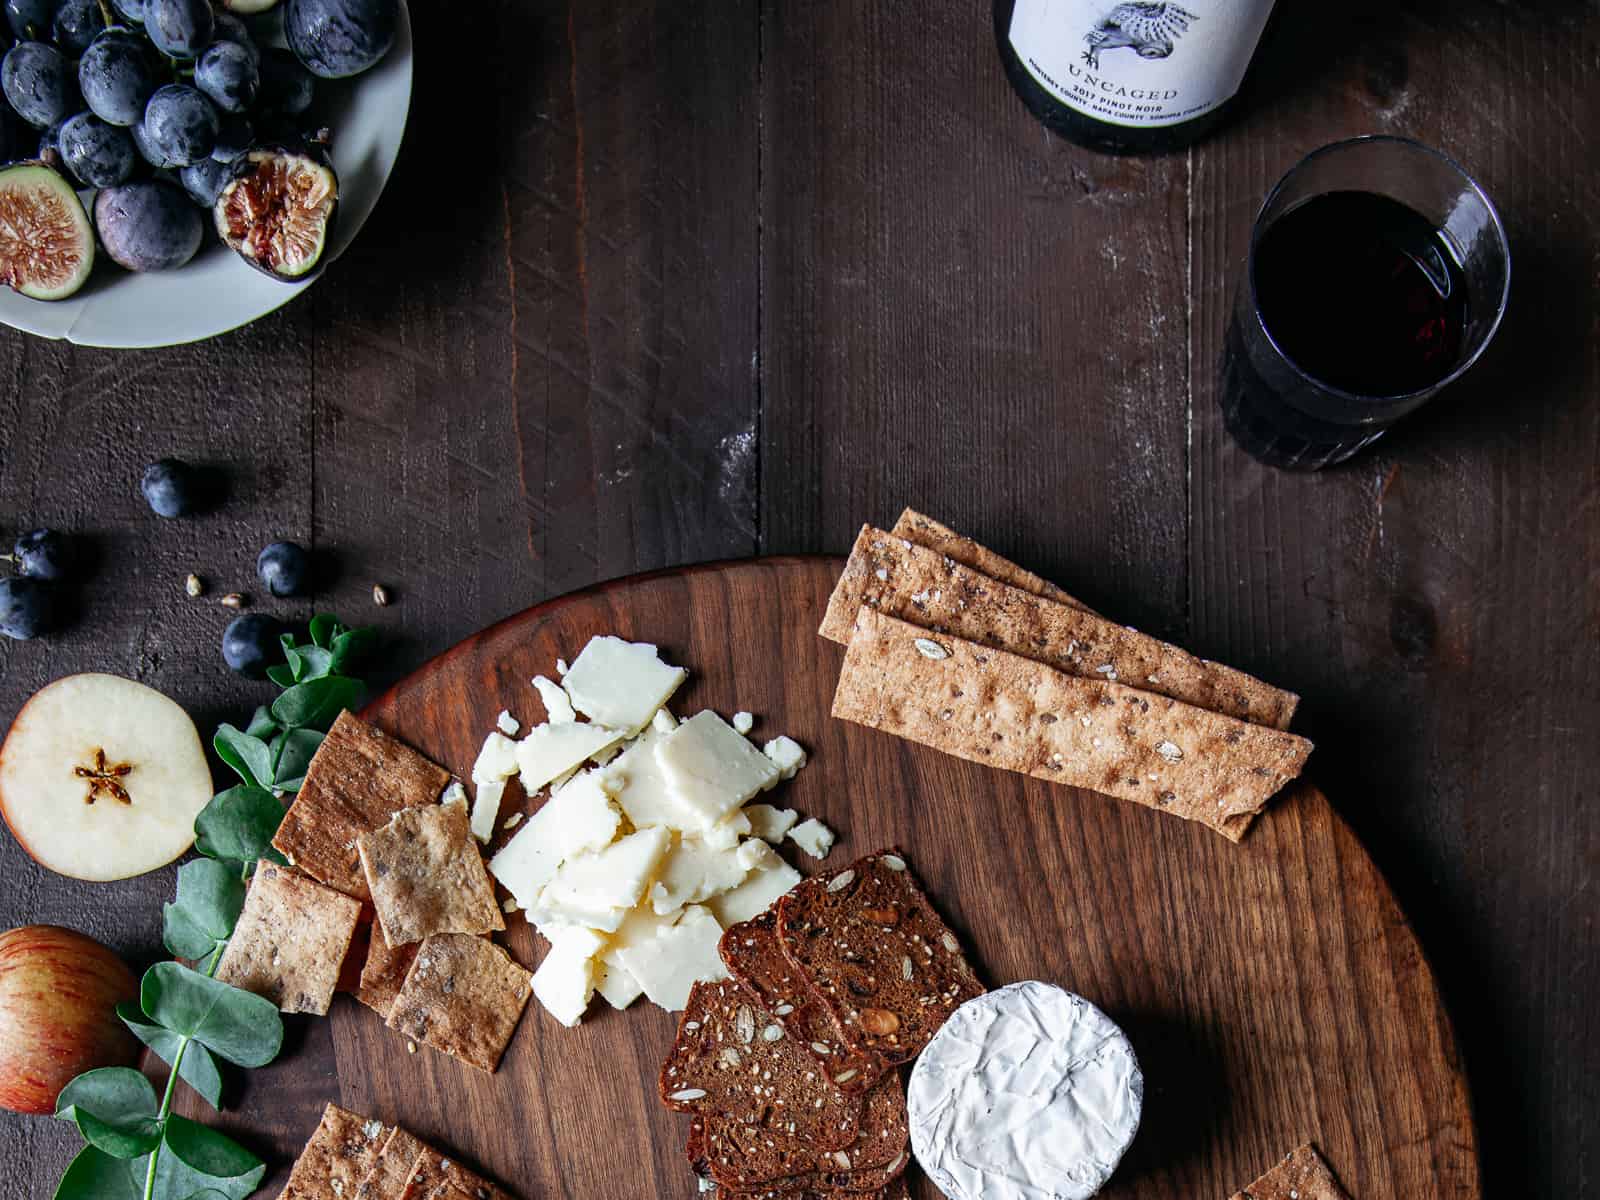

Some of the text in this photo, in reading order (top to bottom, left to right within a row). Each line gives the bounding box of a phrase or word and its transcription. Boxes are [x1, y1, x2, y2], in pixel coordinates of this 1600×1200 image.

[1069, 64, 1178, 100] UNCAGED
[1073, 84, 1163, 113] 2017 PINOT NOIR
[1060, 87, 1087, 105] COUNTY
[1092, 104, 1112, 115] NAPA
[1114, 111, 1145, 120] COUNTY
